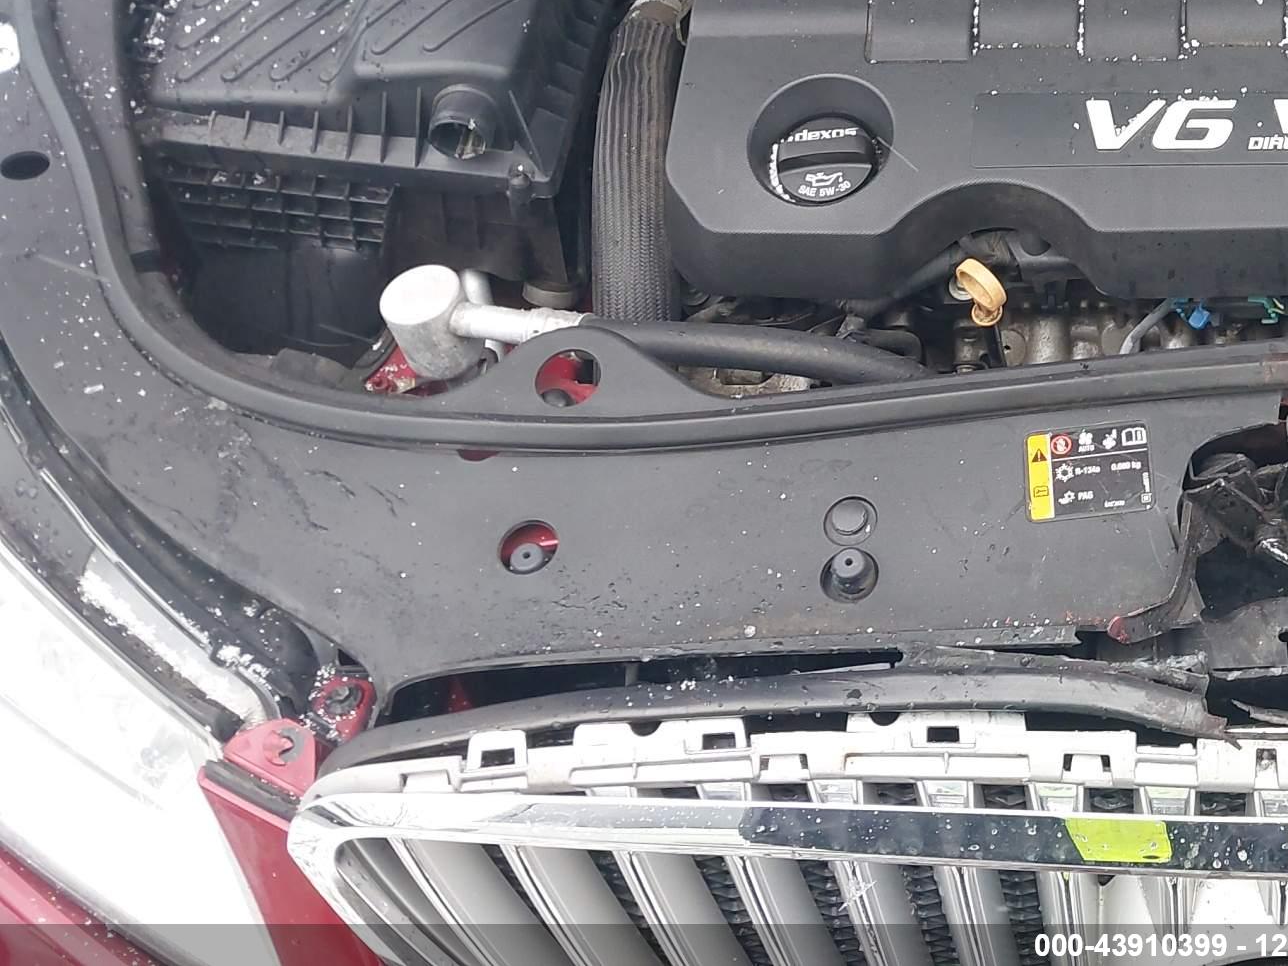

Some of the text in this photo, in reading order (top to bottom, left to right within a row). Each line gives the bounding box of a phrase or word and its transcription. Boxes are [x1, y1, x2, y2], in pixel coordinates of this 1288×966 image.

[1085, 97, 1238, 151] V6
[795, 128, 859, 142] dexos
[798, 180, 851, 197] SAE 5W-30
